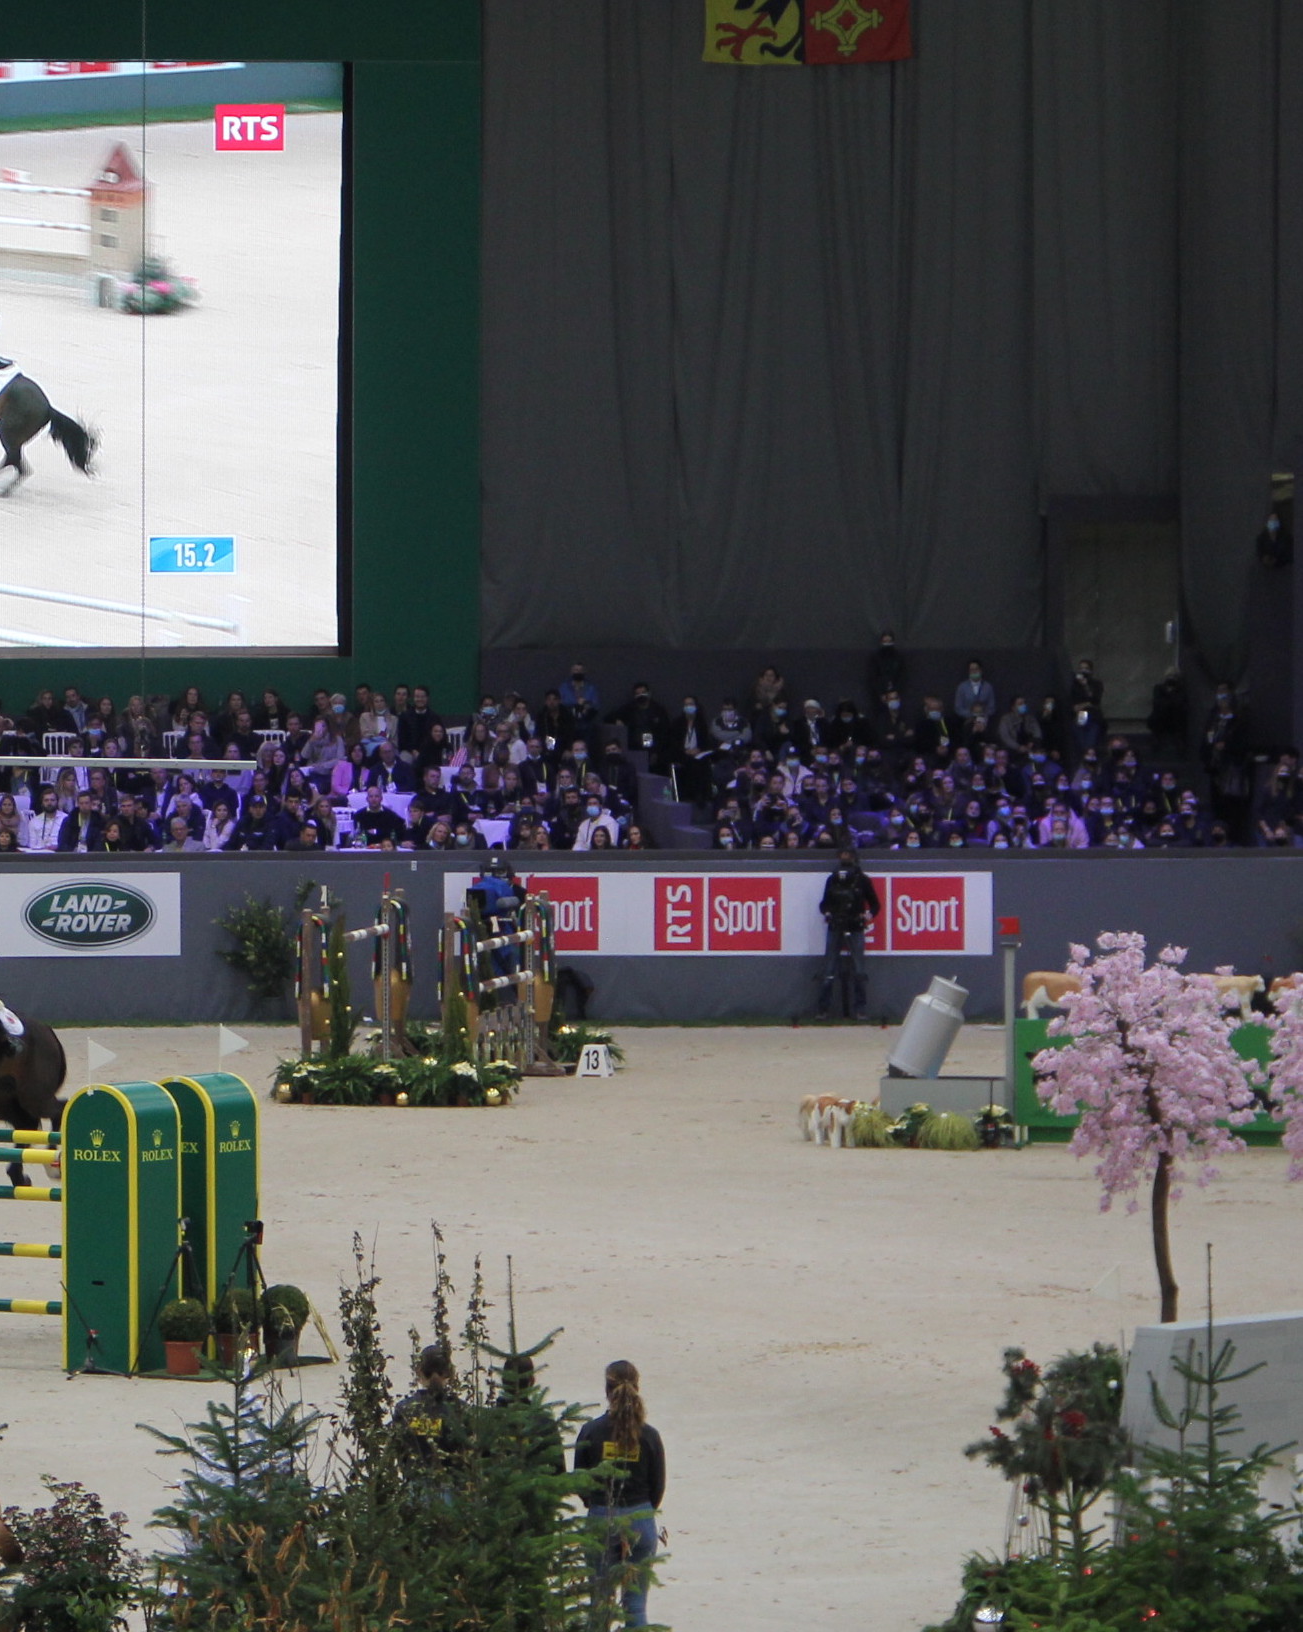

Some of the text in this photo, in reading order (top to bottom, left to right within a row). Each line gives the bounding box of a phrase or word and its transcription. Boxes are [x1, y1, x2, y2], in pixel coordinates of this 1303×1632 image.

[222, 115, 279, 141] RTS
[173, 542, 216, 567] 15.2
[49, 894, 112, 913] LAND
[666, 884, 692, 943] RTS
[54, 914, 132, 933] ROVER
[714, 894, 776, 935] Sport
[897, 894, 959, 935] Sport
[585, 1050, 600, 1070] 13
[73, 1149, 122, 1162] ROLEX
[141, 1149, 174, 1162] ROLEX
[219, 1139, 251, 1153] ROLEX
